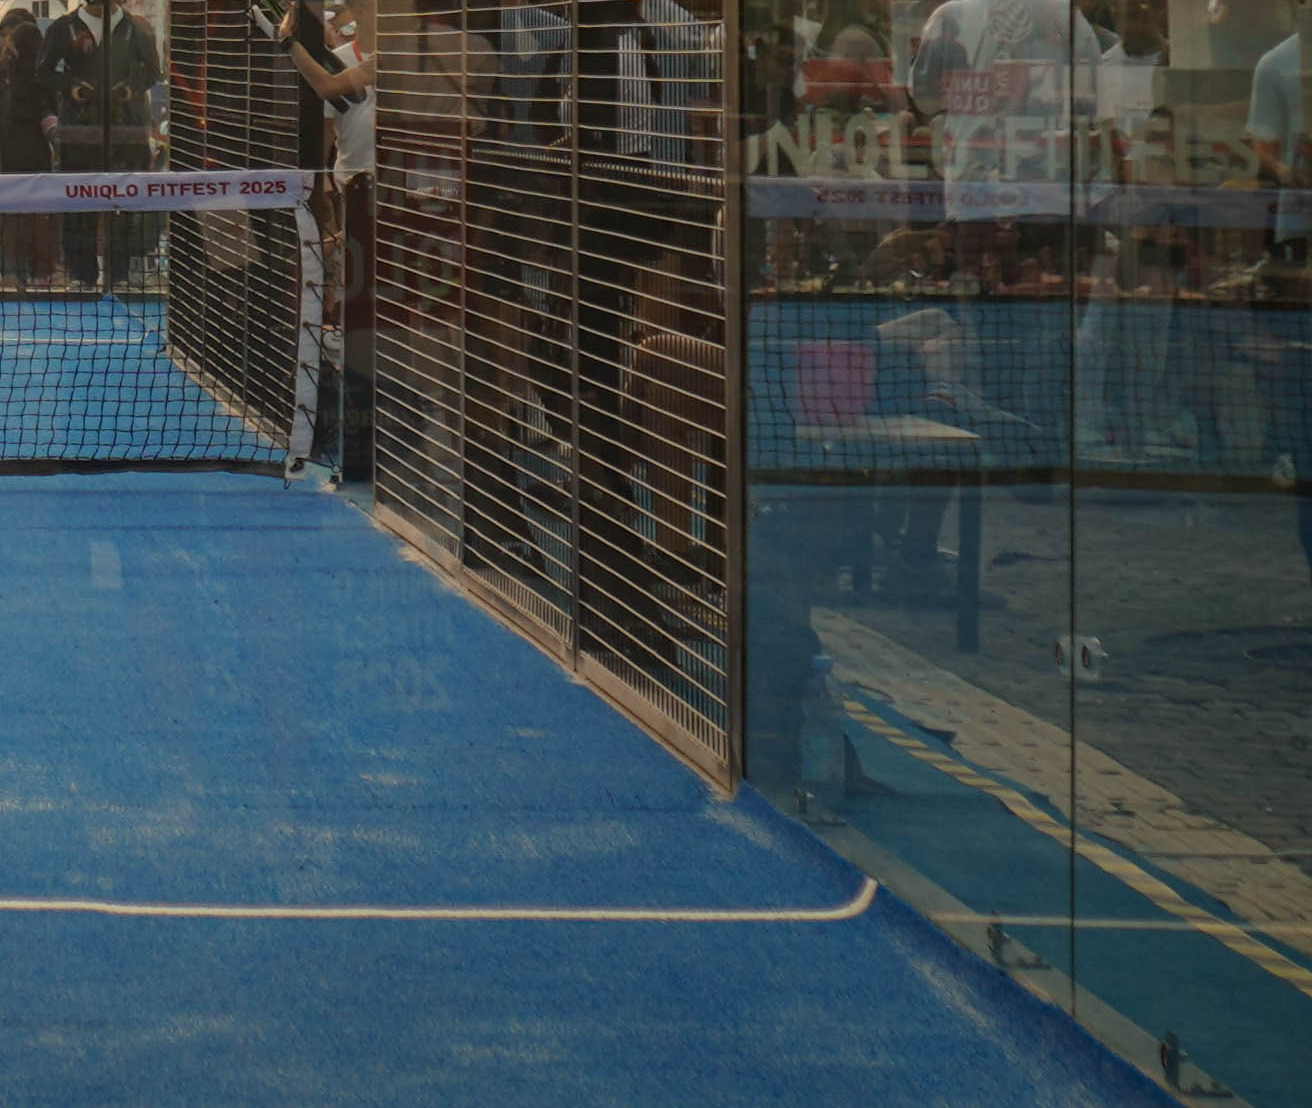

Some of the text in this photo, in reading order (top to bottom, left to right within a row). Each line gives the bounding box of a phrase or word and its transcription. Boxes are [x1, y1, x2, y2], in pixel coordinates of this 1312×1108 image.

[65, 180, 288, 200] UNIQLO FITFEST 2025
